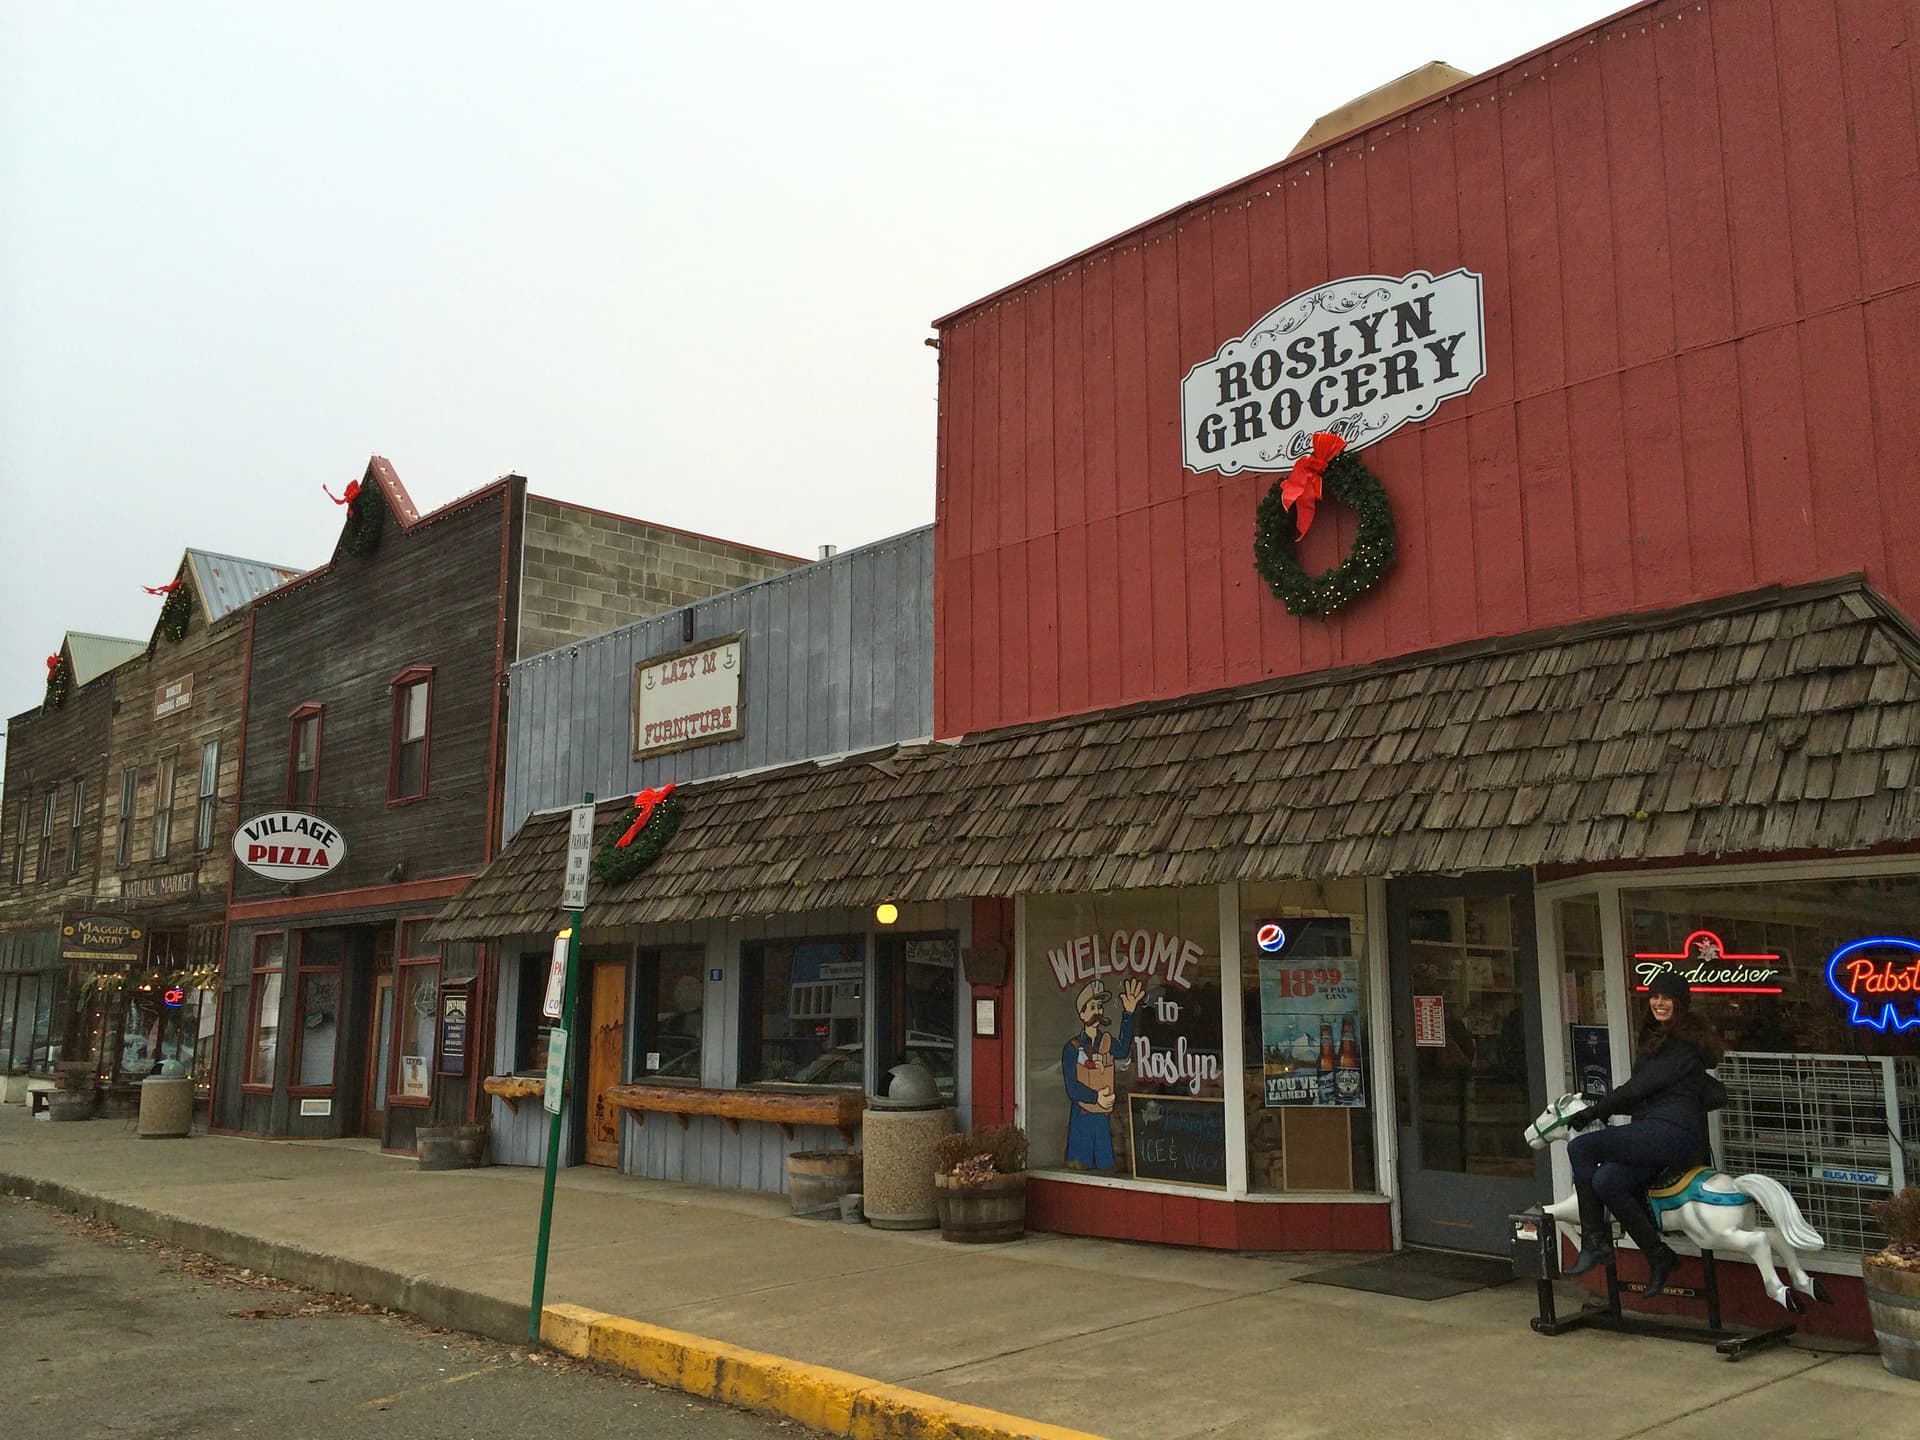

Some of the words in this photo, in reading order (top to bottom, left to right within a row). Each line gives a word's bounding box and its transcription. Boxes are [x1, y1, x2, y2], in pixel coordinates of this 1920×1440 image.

[1216, 292, 1437, 407] ROSLYN
[1196, 331, 1466, 454] GROCERY
[660, 657, 697, 686] LAZY
[702, 651, 718, 674] M
[644, 705, 733, 745] FURNITURE
[244, 816, 338, 848] VILLAGE
[247, 844, 330, 867] PIZZA
[124, 878, 157, 898] NATURAL
[160, 872, 194, 892] MARKET
[82, 933, 124, 945] PANTRY
[1048, 928, 1205, 990] WELCOME
[1635, 961, 1778, 986] Bdweiser
[1156, 995, 1183, 1024] to
[1134, 1035, 1222, 1097] Roslyn
[1267, 1076, 1319, 1092] YOU'VE
[1268, 1091, 1308, 1101] EARNED
[1831, 1171, 1848, 1181] USA
[1849, 1171, 1878, 1183] TODAY
